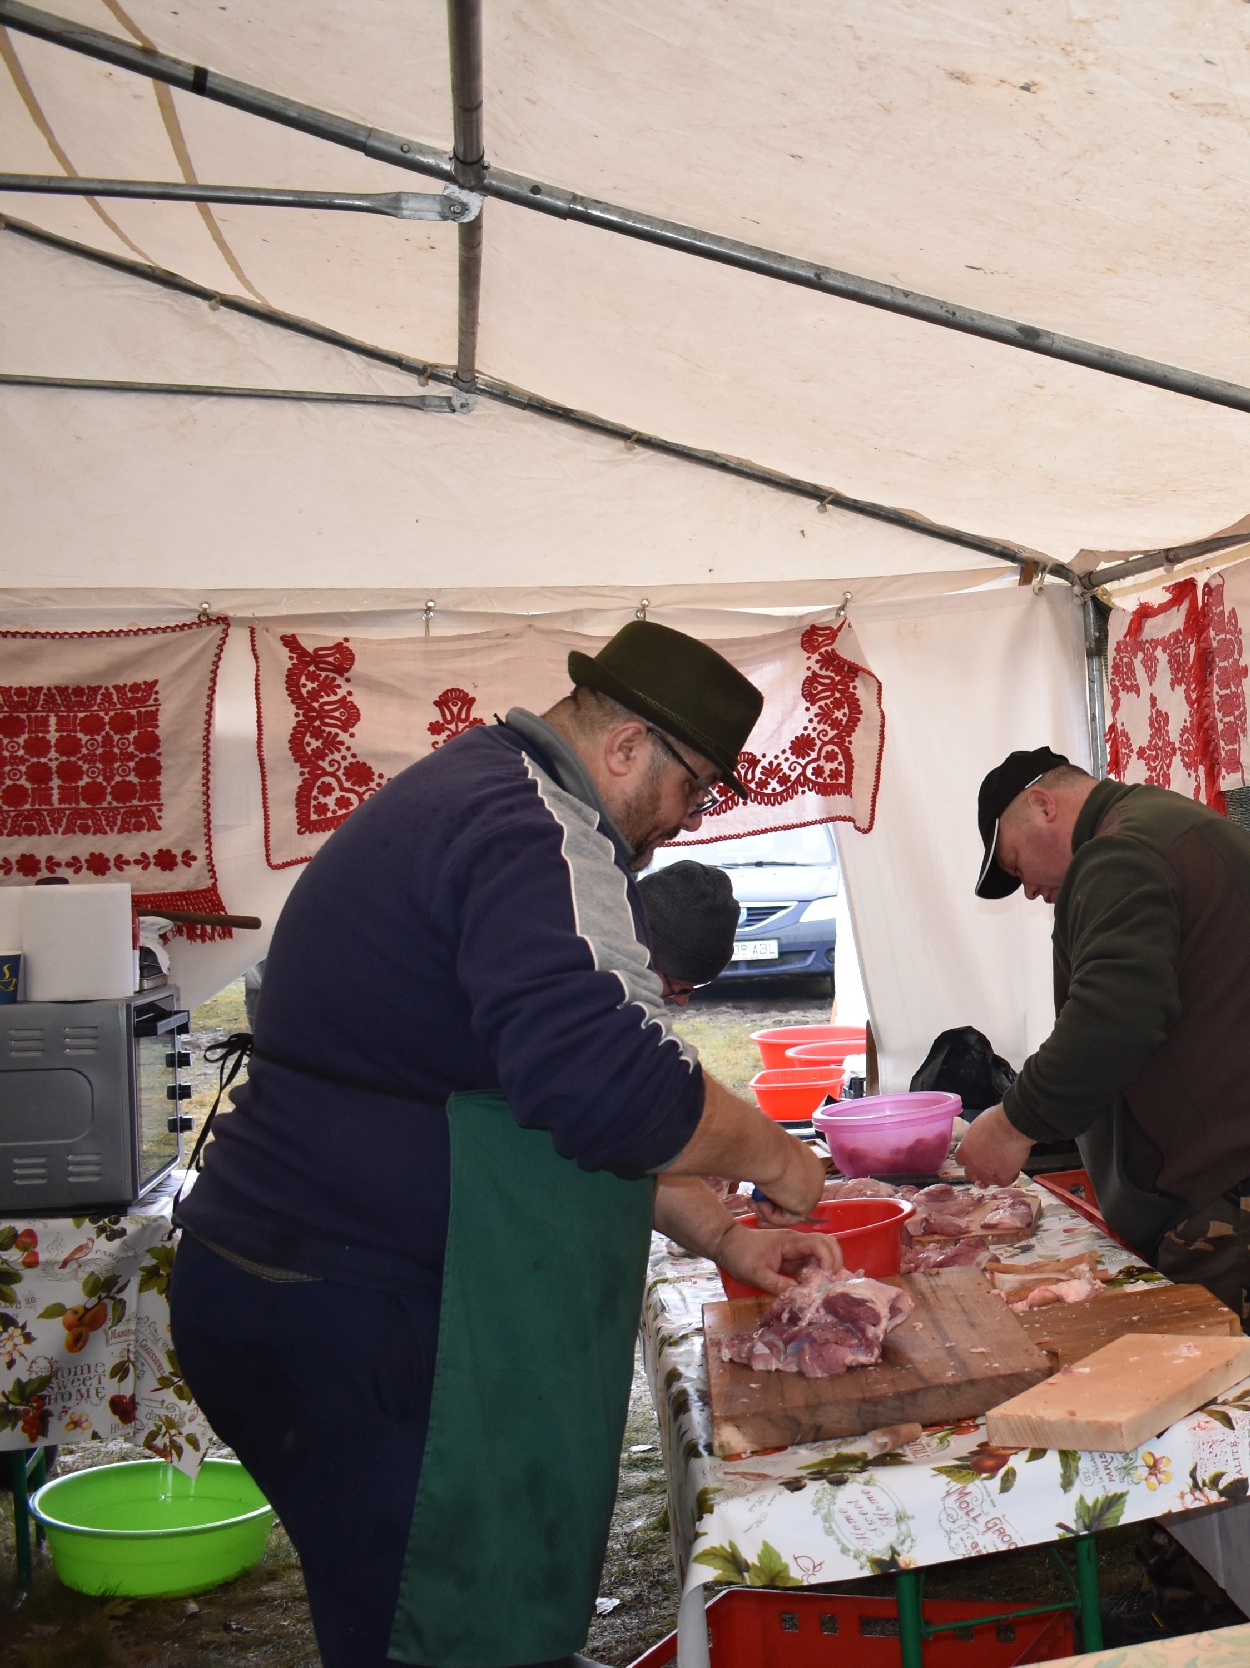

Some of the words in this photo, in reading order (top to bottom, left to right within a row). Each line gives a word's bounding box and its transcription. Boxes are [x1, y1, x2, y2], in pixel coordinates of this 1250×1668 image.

[752, 943, 776, 955] ABL
[1098, 1452, 1116, 1483] PARIS
[1229, 1440, 1243, 1476] ALITÉ
